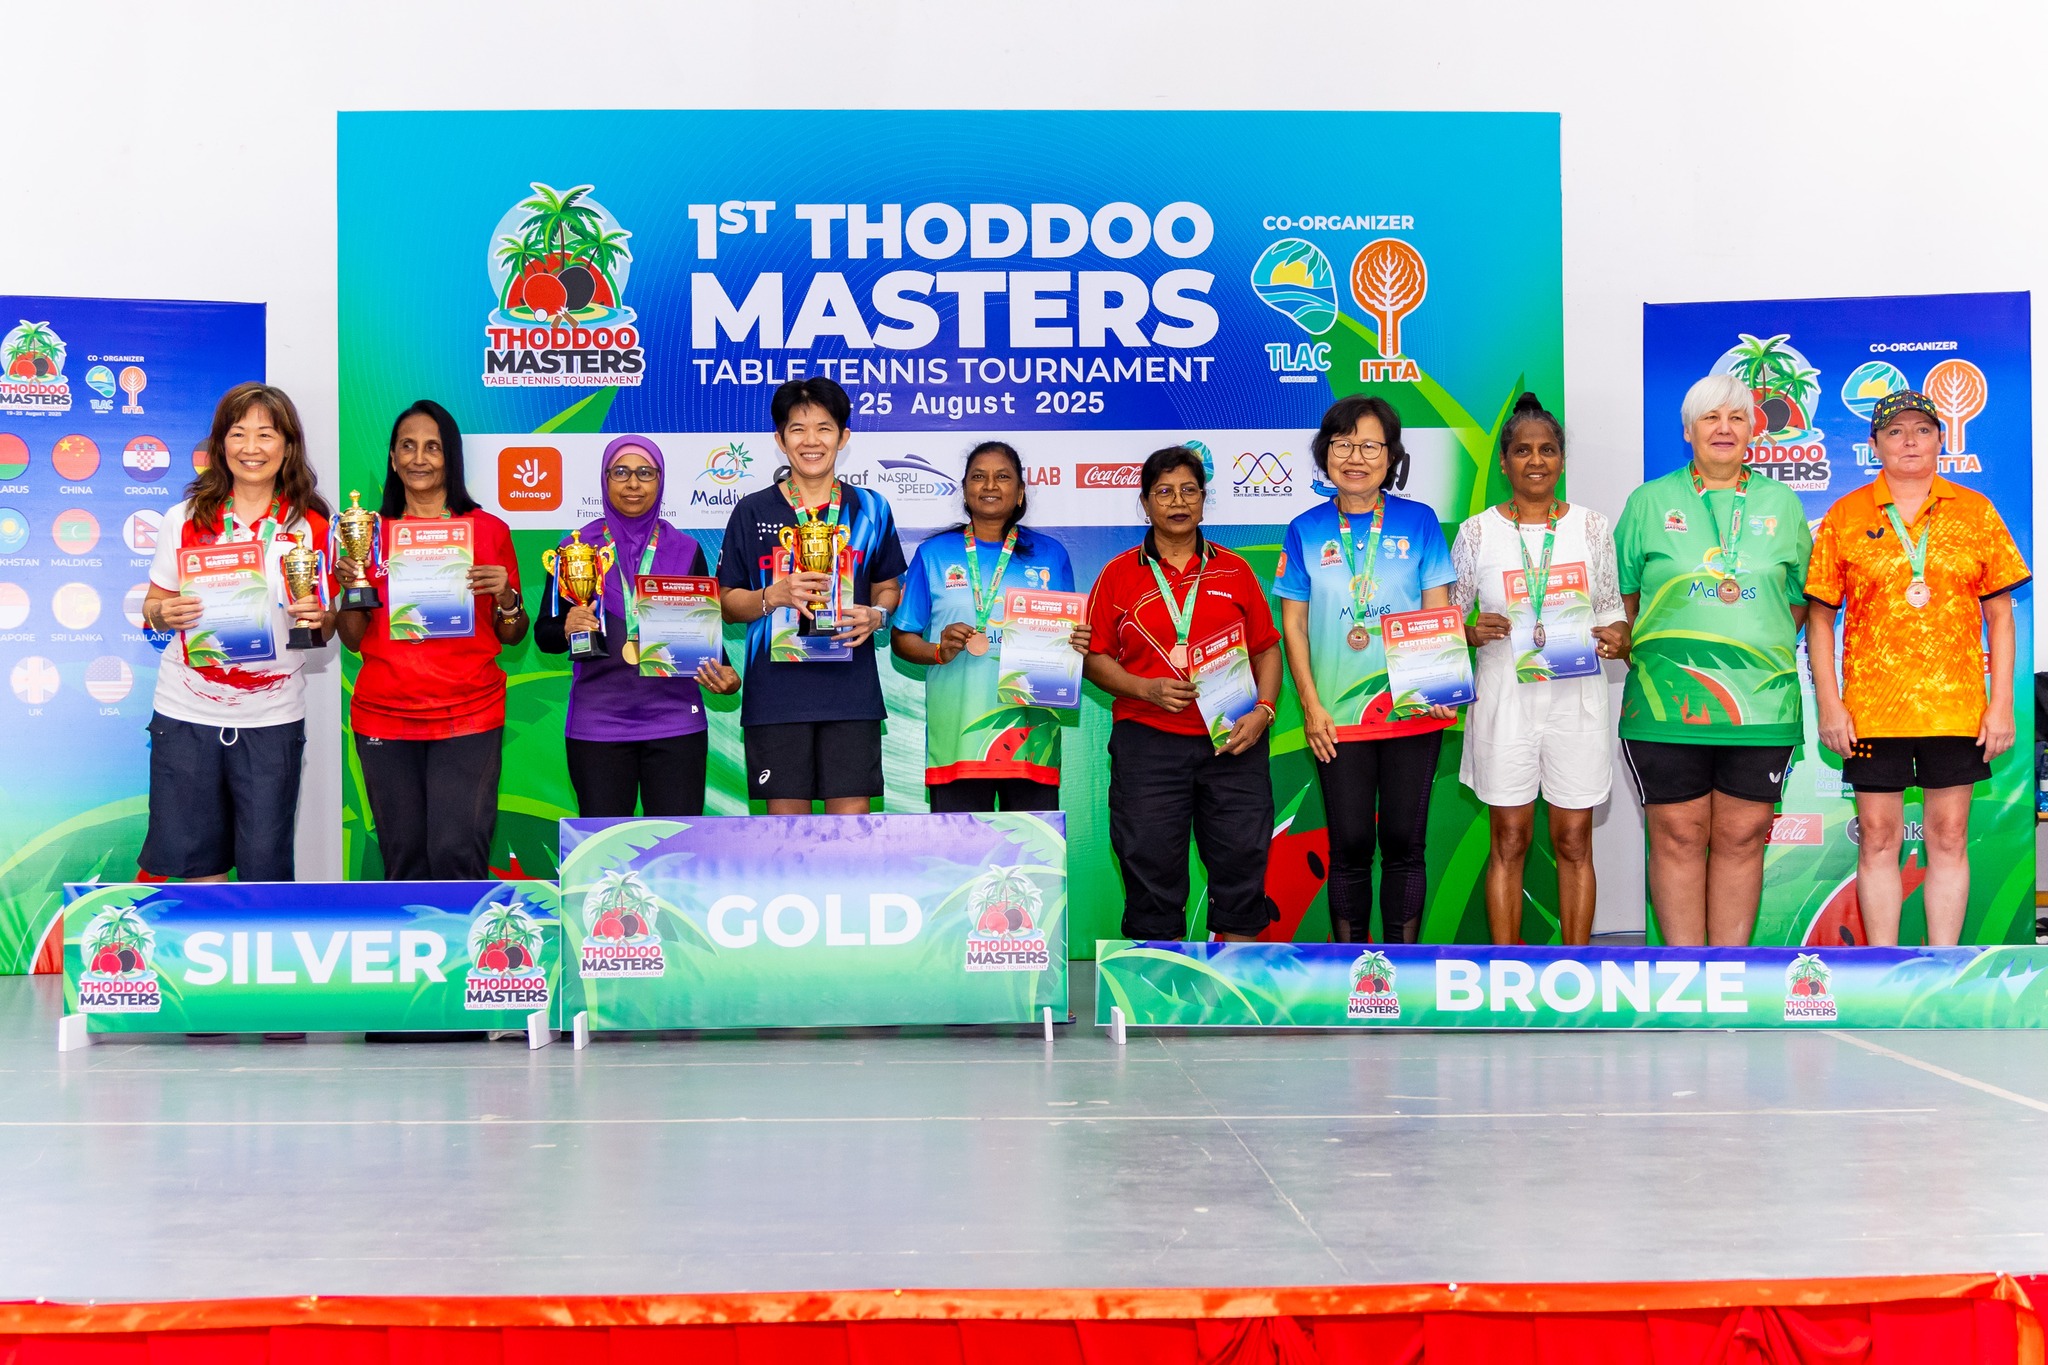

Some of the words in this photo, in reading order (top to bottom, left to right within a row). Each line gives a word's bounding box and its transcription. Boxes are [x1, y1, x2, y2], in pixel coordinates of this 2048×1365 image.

[1262, 215, 1415, 231] CO-ORGANIZER
[687, 200, 776, 260] 1ST
[795, 201, 1214, 260] THODDOO
[691, 269, 1219, 350] MASTERS
[487, 328, 637, 350] THODDOO
[1870, 341, 1958, 353] CO-ORGANIZER
[487, 349, 643, 374] MASTERS
[1265, 343, 1331, 371] TLAC
[692, 359, 806, 385] TABLE
[817, 358, 948, 385] TENNIS
[957, 356, 1215, 384] TOURNAMENT
[1361, 360, 1421, 382] ITTA
[484, 376, 519, 385] TABLE
[521, 376, 561, 385] TENNIS
[564, 375, 640, 385] TOURNAMENT
[0, 384, 68, 394] THODDOO
[0, 393, 70, 405] MASTERS
[90, 400, 114, 410] TLAC
[122, 406, 144, 414] ITTA
[911, 391, 1015, 420] August
[1035, 391, 1105, 414] 2025
[1743, 444, 1824, 464] ODDOO
[1853, 444, 1881, 465] TL
[1938, 455, 1981, 472] TTA
[877, 472, 918, 483] NASRU
[1022, 466, 1061, 486] LAB
[1083, 465, 1142, 486] Coca-Cola
[1750, 462, 1829, 481] STERS
[60, 486, 93, 495] CHINA
[124, 486, 169, 495] CROATIA
[897, 484, 935, 495] SPEED
[1233, 485, 1293, 493] STELCO
[1786, 482, 1827, 490] NAMENT
[509, 490, 552, 500] dhiraagu
[582, 496, 603, 506] Mini
[690, 488, 746, 507] Maldiv
[403, 547, 460, 556] CERTIFICATE
[51, 559, 103, 568] MALDIVES
[130, 559, 152, 568] NEP
[194, 571, 252, 584] CERTIFICATE
[1206, 590, 1233, 600] TIBHAR
[1688, 581, 1757, 599] Males
[1521, 591, 1577, 604] CEIFICATE
[1543, 600, 1565, 608] AWARD
[1339, 603, 1391, 620] Mdives
[1017, 617, 1072, 629] CERTIFICATE
[51, 633, 67, 642] SRI
[69, 633, 104, 642] LANKA
[121, 633, 174, 642] THAILAND
[1398, 635, 1452, 648] CERTIFICATE
[1420, 643, 1441, 651] AWARD
[1199, 648, 1239, 673] CERTIFICATE
[28, 708, 43, 717] UK
[99, 708, 121, 717] USA
[707, 893, 923, 949] GOLD
[968, 940, 1045, 952] THODDOO
[183, 930, 448, 986] SILVER
[582, 946, 661, 959] THODDOO
[967, 951, 1048, 965] MASTERS
[582, 957, 664, 971] MASTERS
[81, 981, 157, 993] THODDOO
[468, 977, 545, 990] THODDOO
[1435, 959, 1748, 1013] BRONZE
[80, 992, 160, 1006] MASTERS
[467, 989, 548, 1003] MASTERS
[1350, 997, 1397, 1006] THODDOO
[1349, 1005, 1400, 1014] MASTERS
[1786, 1000, 1834, 1009] THODDOO
[1785, 1008, 1837, 1017] MASTERS
